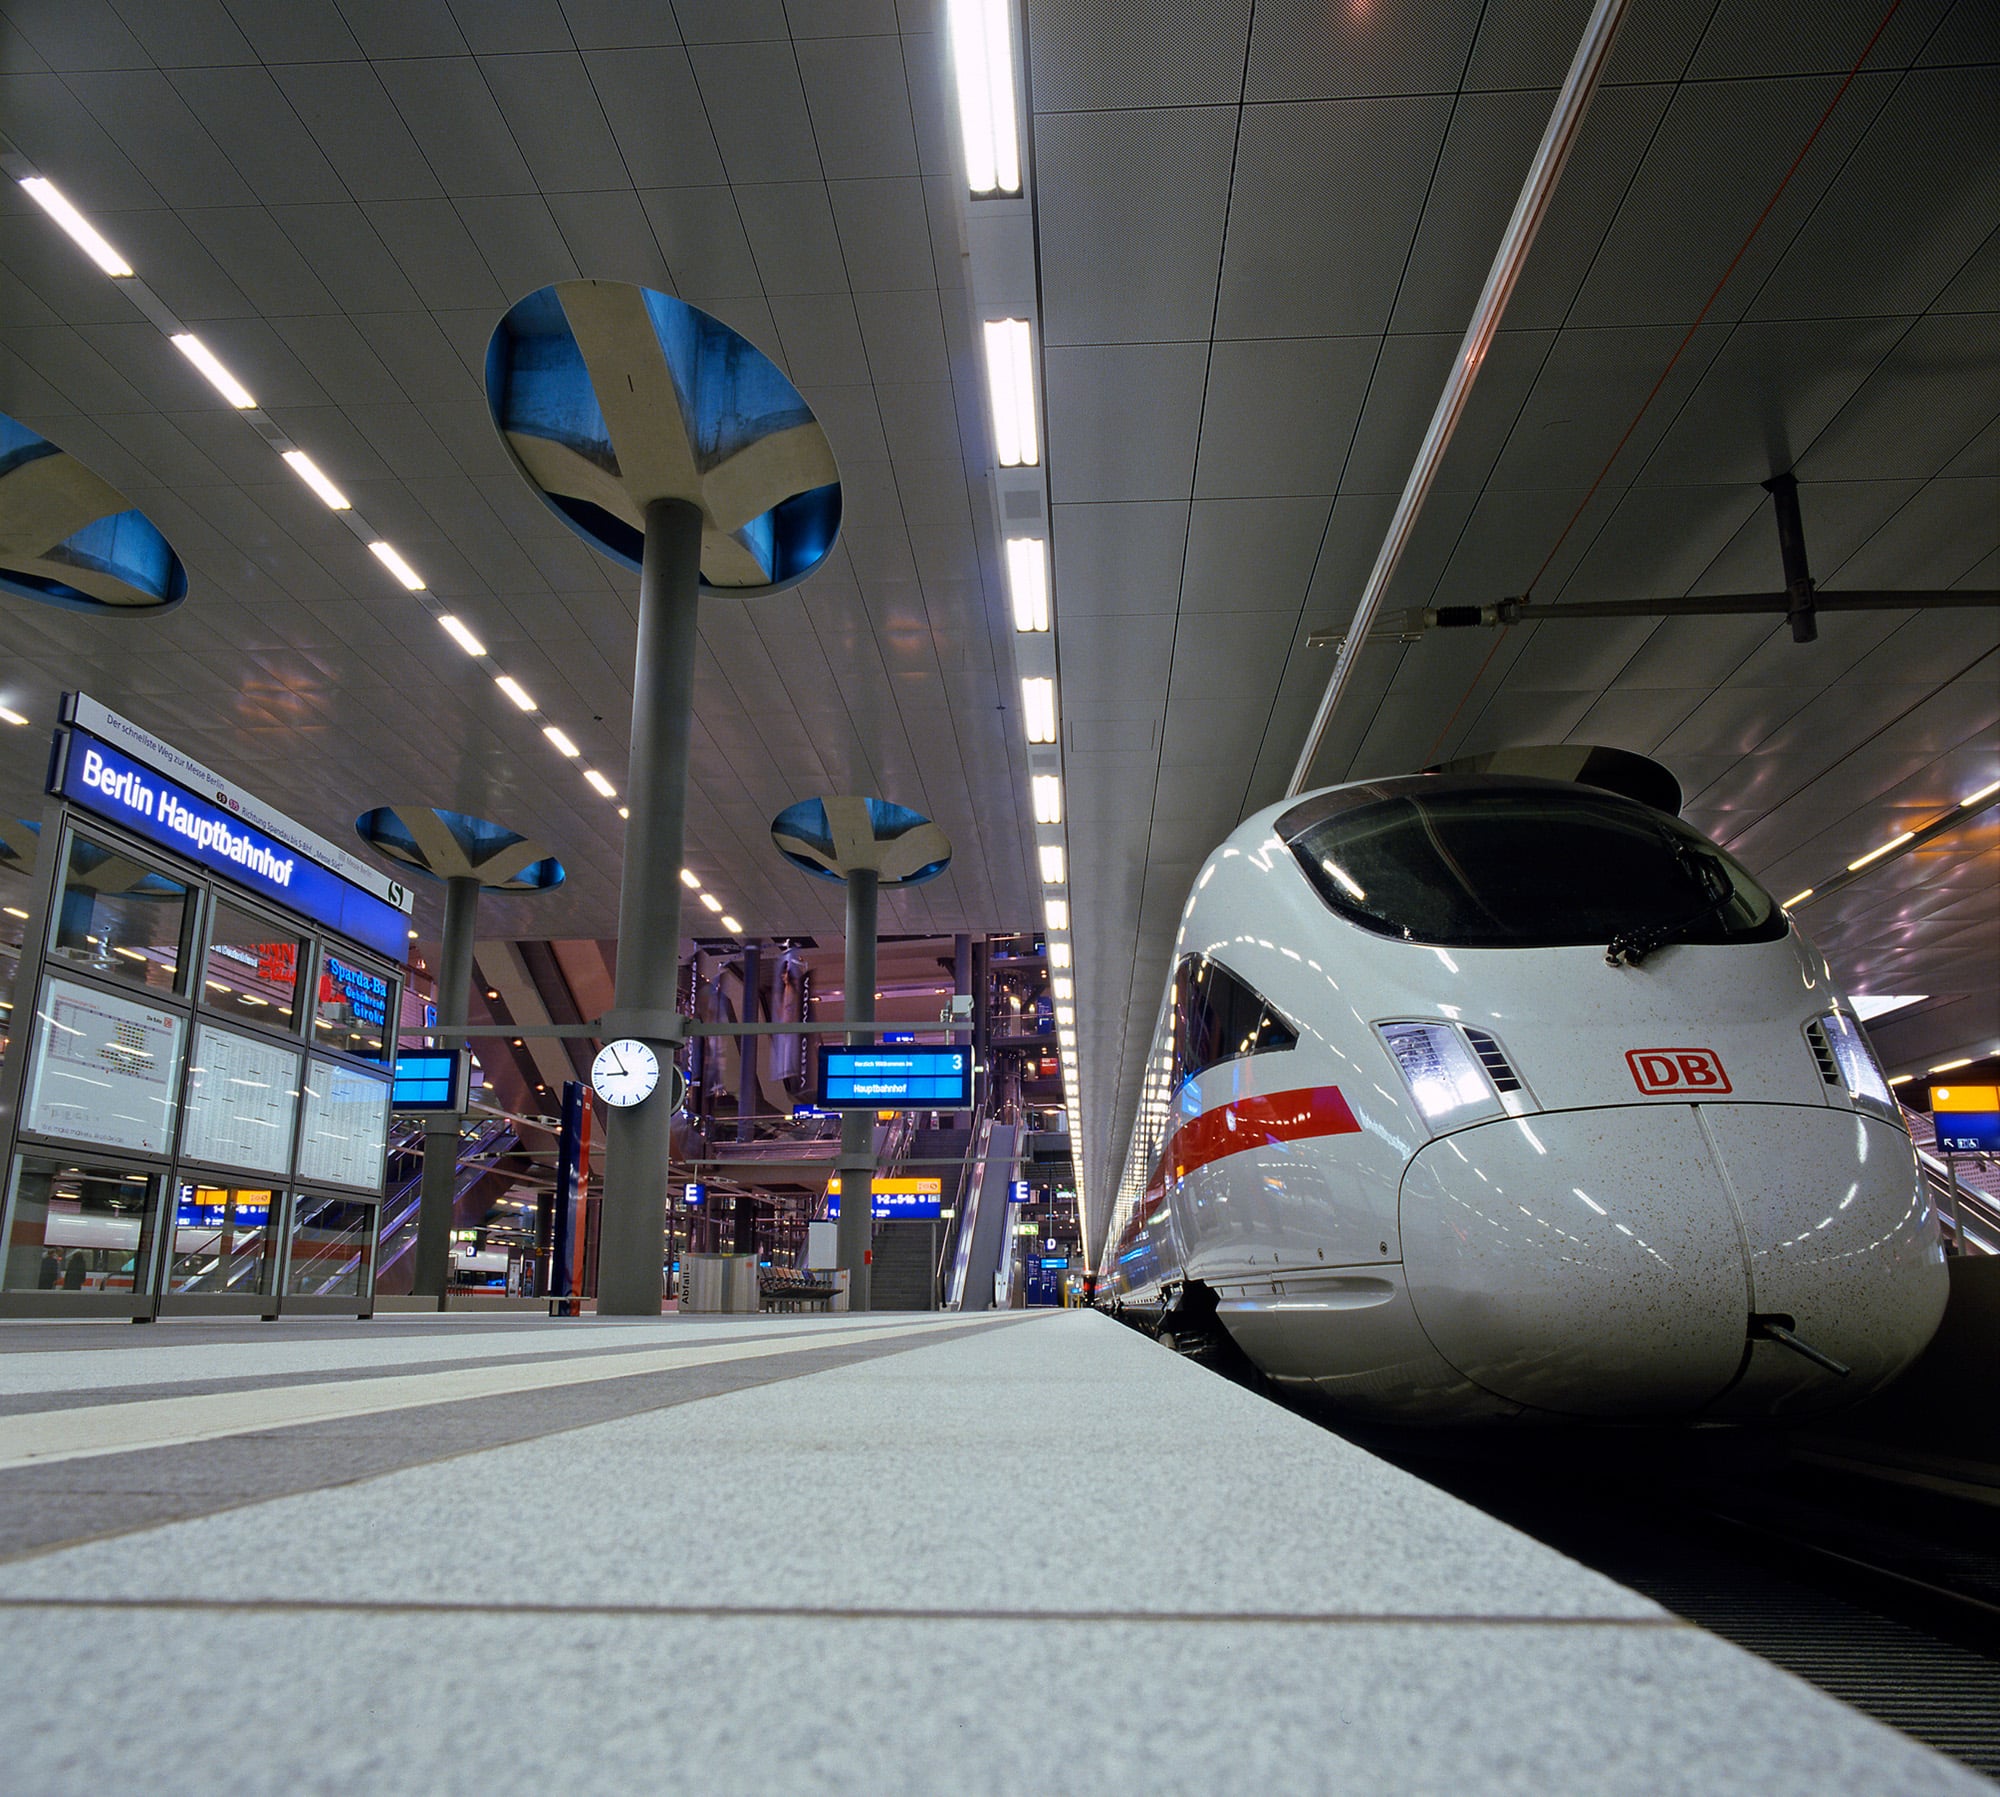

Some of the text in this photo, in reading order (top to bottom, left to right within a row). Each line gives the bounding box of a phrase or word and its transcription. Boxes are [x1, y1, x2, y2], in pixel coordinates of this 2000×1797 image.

[106, 714, 225, 790] Der schnellste Weg zur Messe Berlin
[82, 750, 293, 887] Berlin Hauptbahnhof
[241, 807, 267, 829] Richtung
[952, 1054, 963, 1070] 3
[1637, 1053, 1721, 1088] DB
[853, 1083, 907, 1095] Hauptbahnhof
[181, 1185, 193, 1202] E
[685, 1184, 698, 1201] E
[1016, 1181, 1028, 1199] E
[466, 1246, 475, 1256] D
[1046, 1238, 1057, 1250] D
[682, 1271, 690, 1304] Abfall
